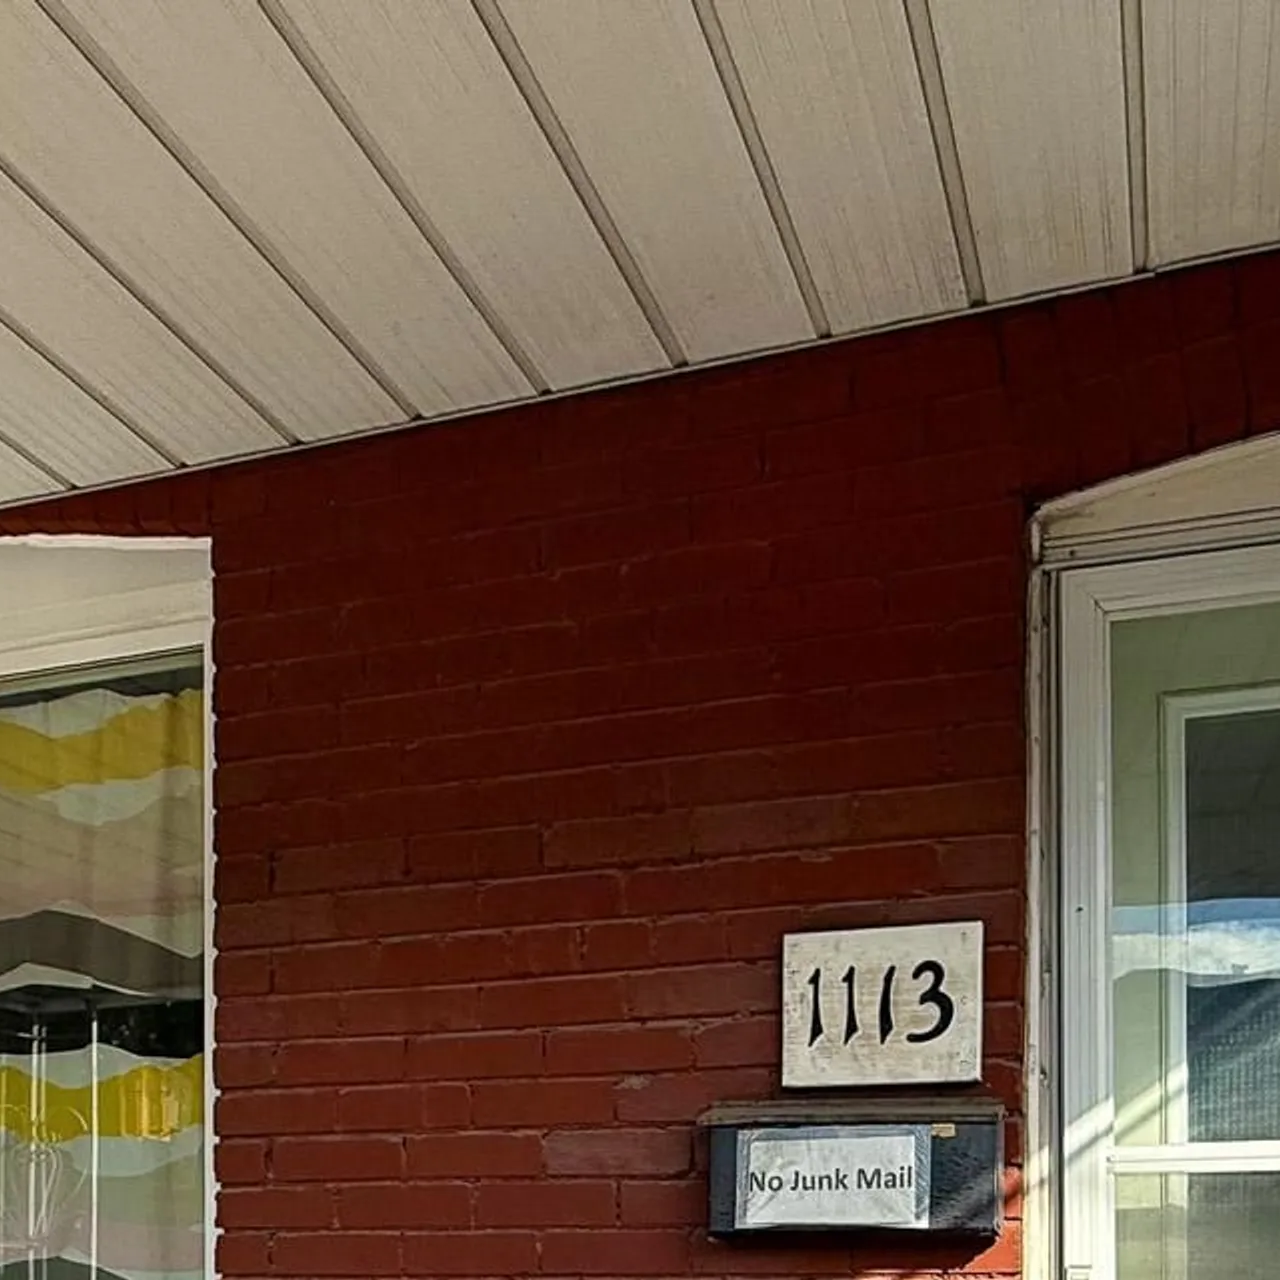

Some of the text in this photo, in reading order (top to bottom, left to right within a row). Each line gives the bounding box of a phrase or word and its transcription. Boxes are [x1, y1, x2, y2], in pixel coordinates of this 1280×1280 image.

[808, 959, 955, 1047] 1113
[749, 1165, 913, 1193] No Junk Mail
